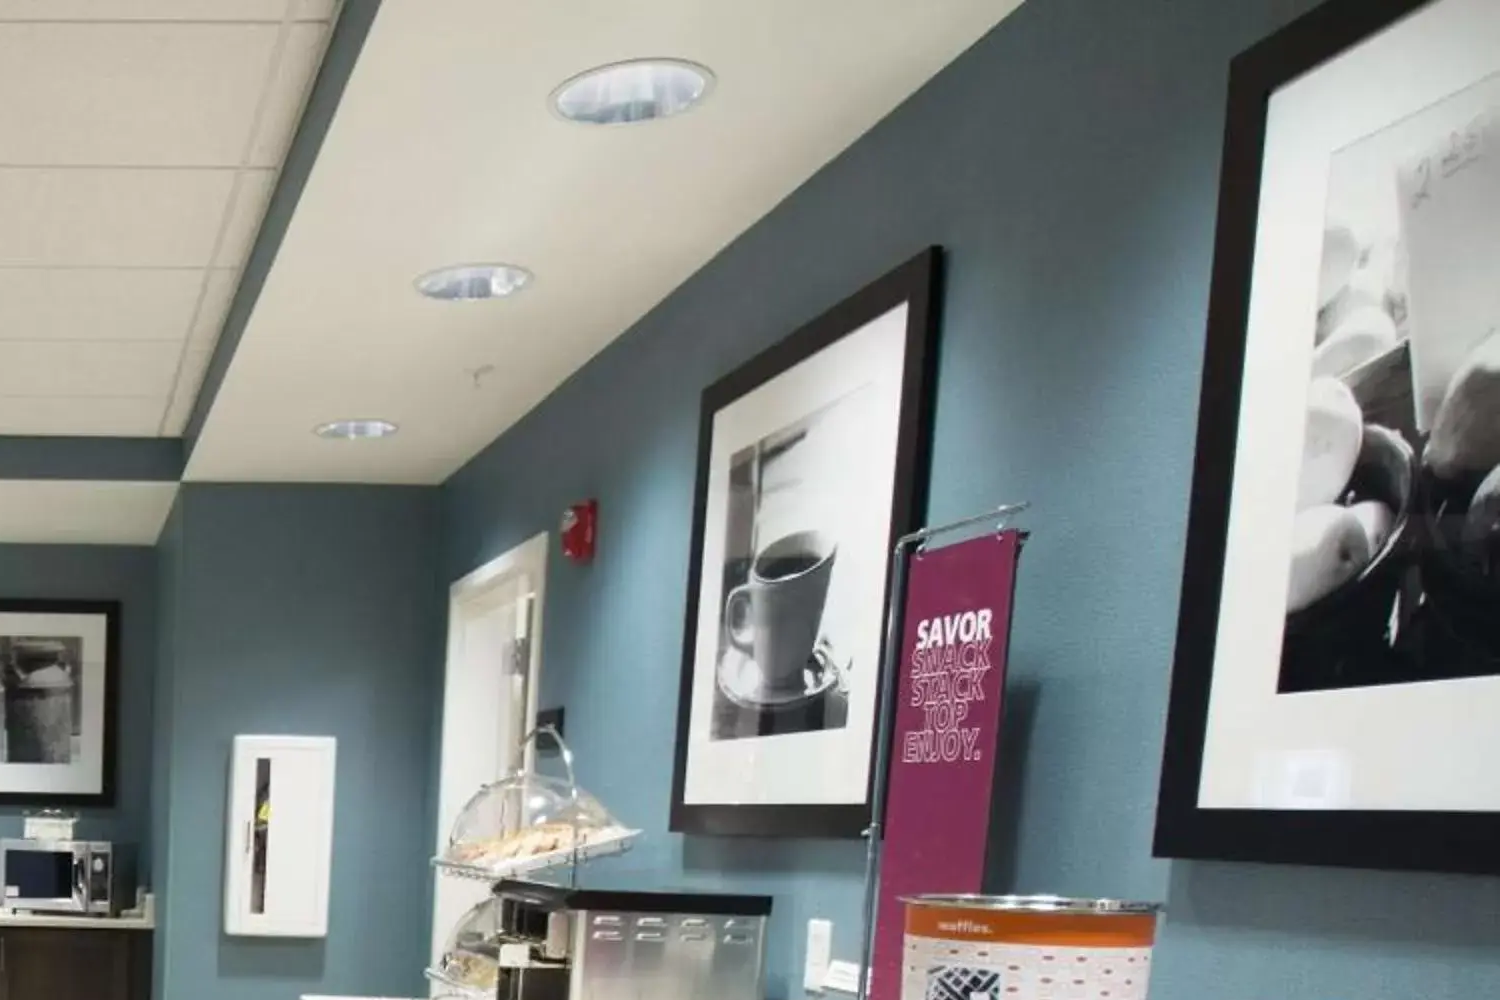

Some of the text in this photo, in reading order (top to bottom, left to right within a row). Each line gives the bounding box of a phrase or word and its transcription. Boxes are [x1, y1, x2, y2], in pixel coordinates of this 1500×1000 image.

[917, 609, 992, 649] SAVOR
[911, 638, 990, 676] SNACK
[911, 669, 985, 707] STACK
[923, 700, 969, 732] TOP
[902, 727, 981, 763] ENJOY.
[938, 919, 993, 933] waffles.
